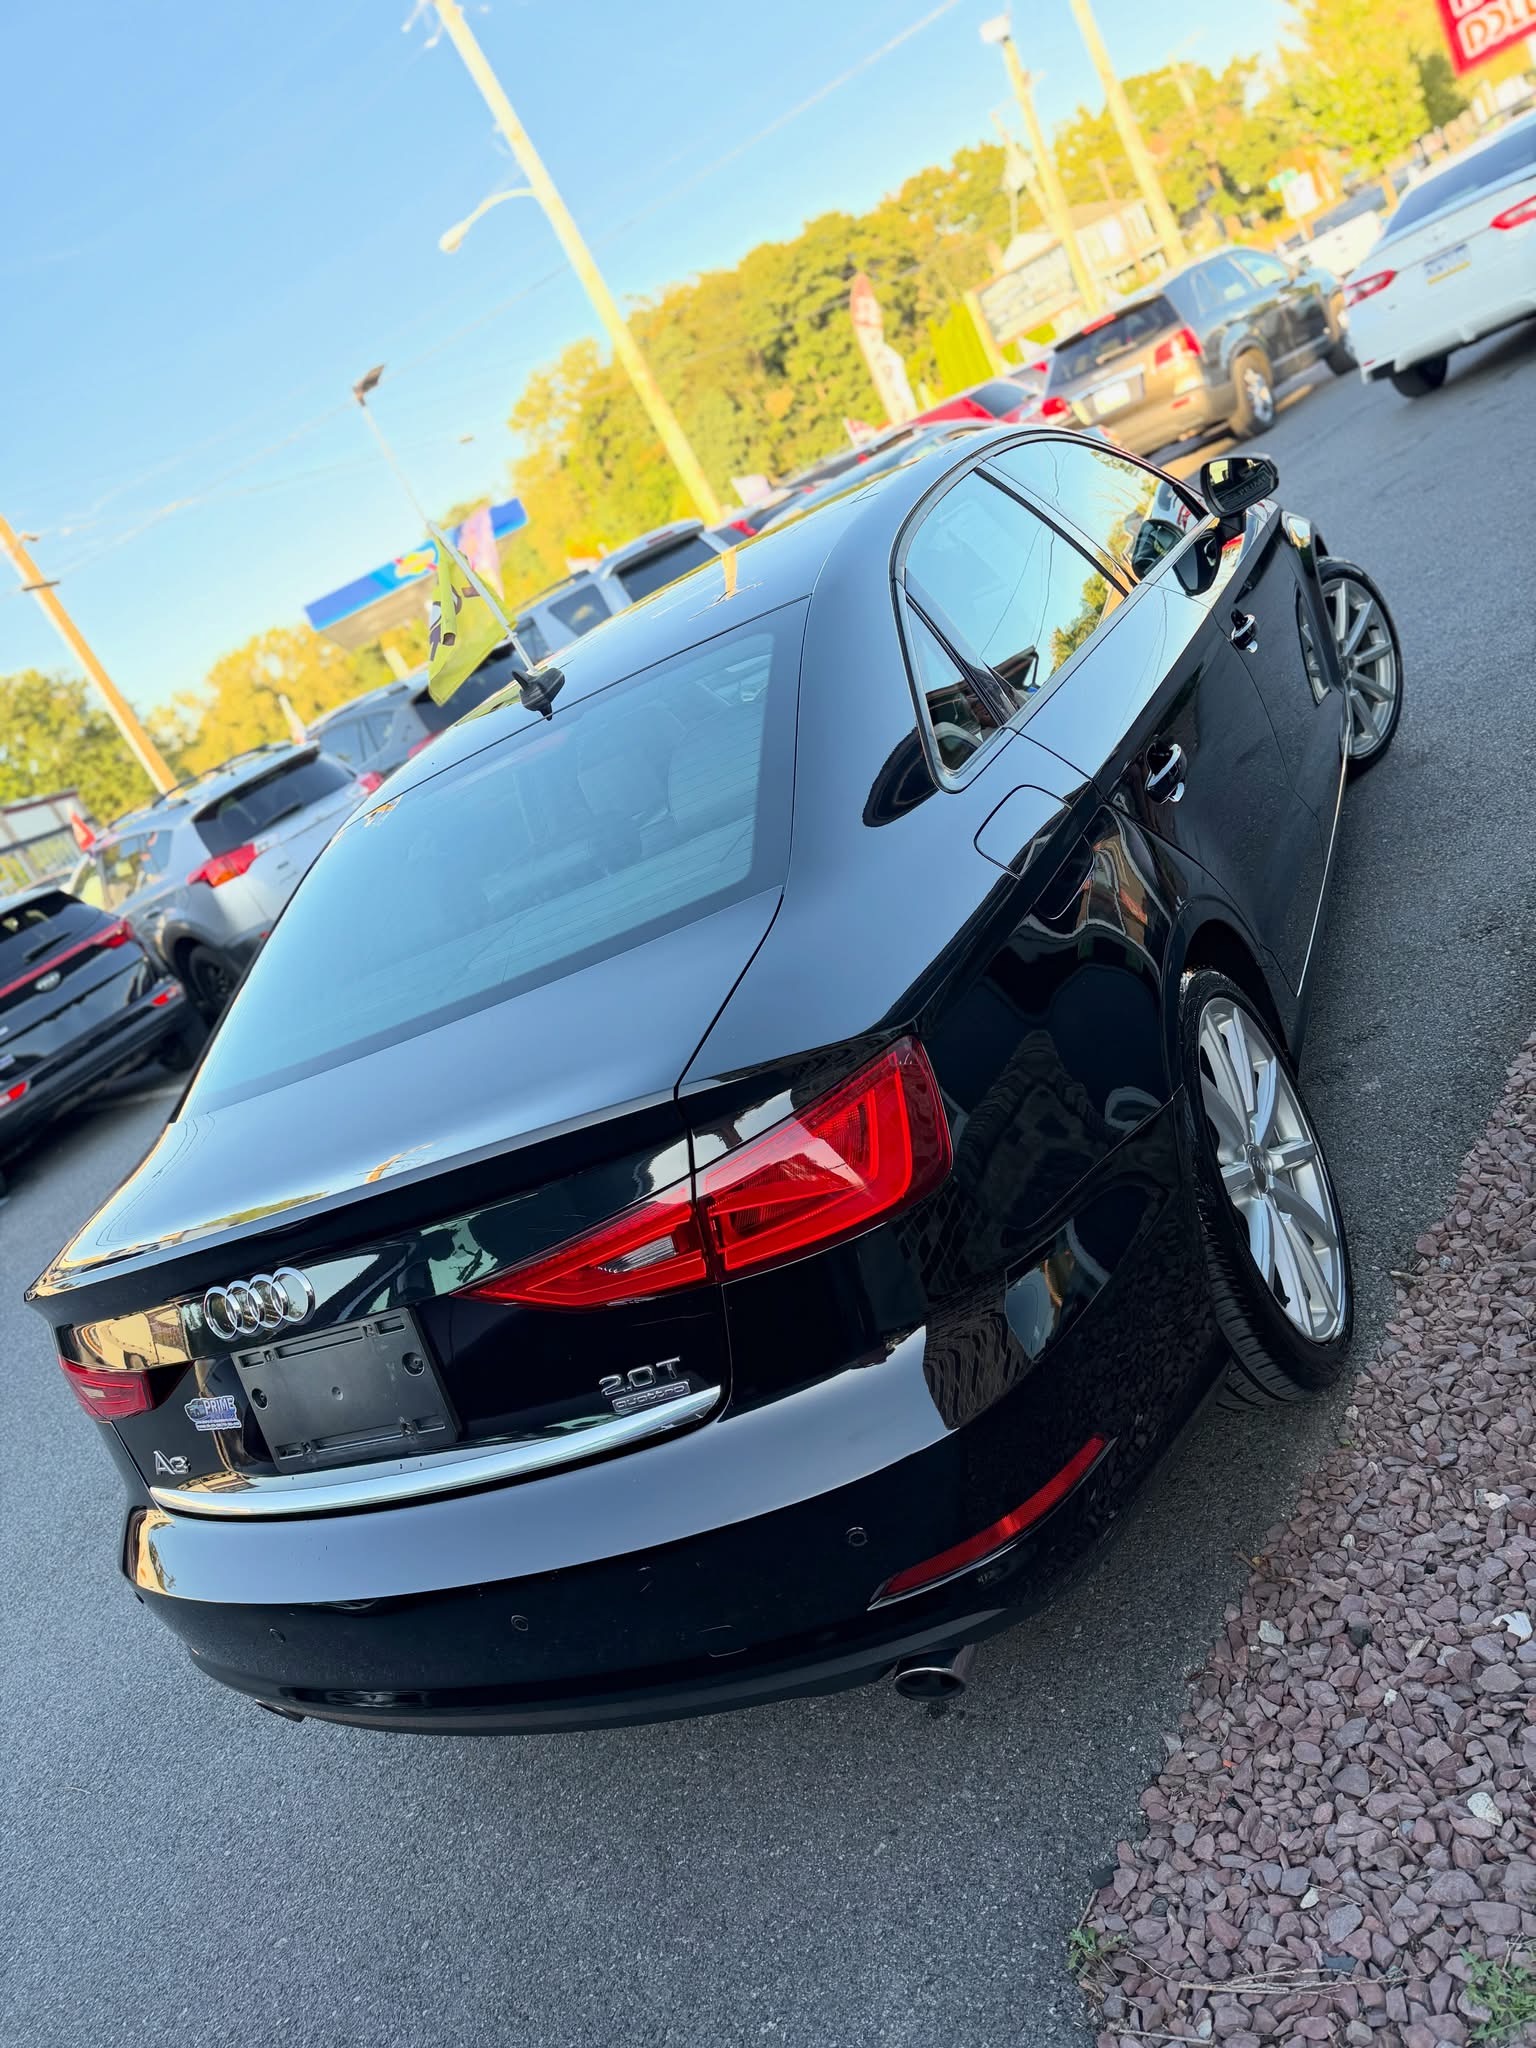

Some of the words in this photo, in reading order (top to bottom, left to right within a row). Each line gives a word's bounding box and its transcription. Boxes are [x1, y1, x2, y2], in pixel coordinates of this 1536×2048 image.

[599, 1356, 680, 1396] 2.0T
[203, 1397, 234, 1415] PRIME
[615, 1385, 686, 1408] quattro
[153, 1450, 189, 1475] A3
